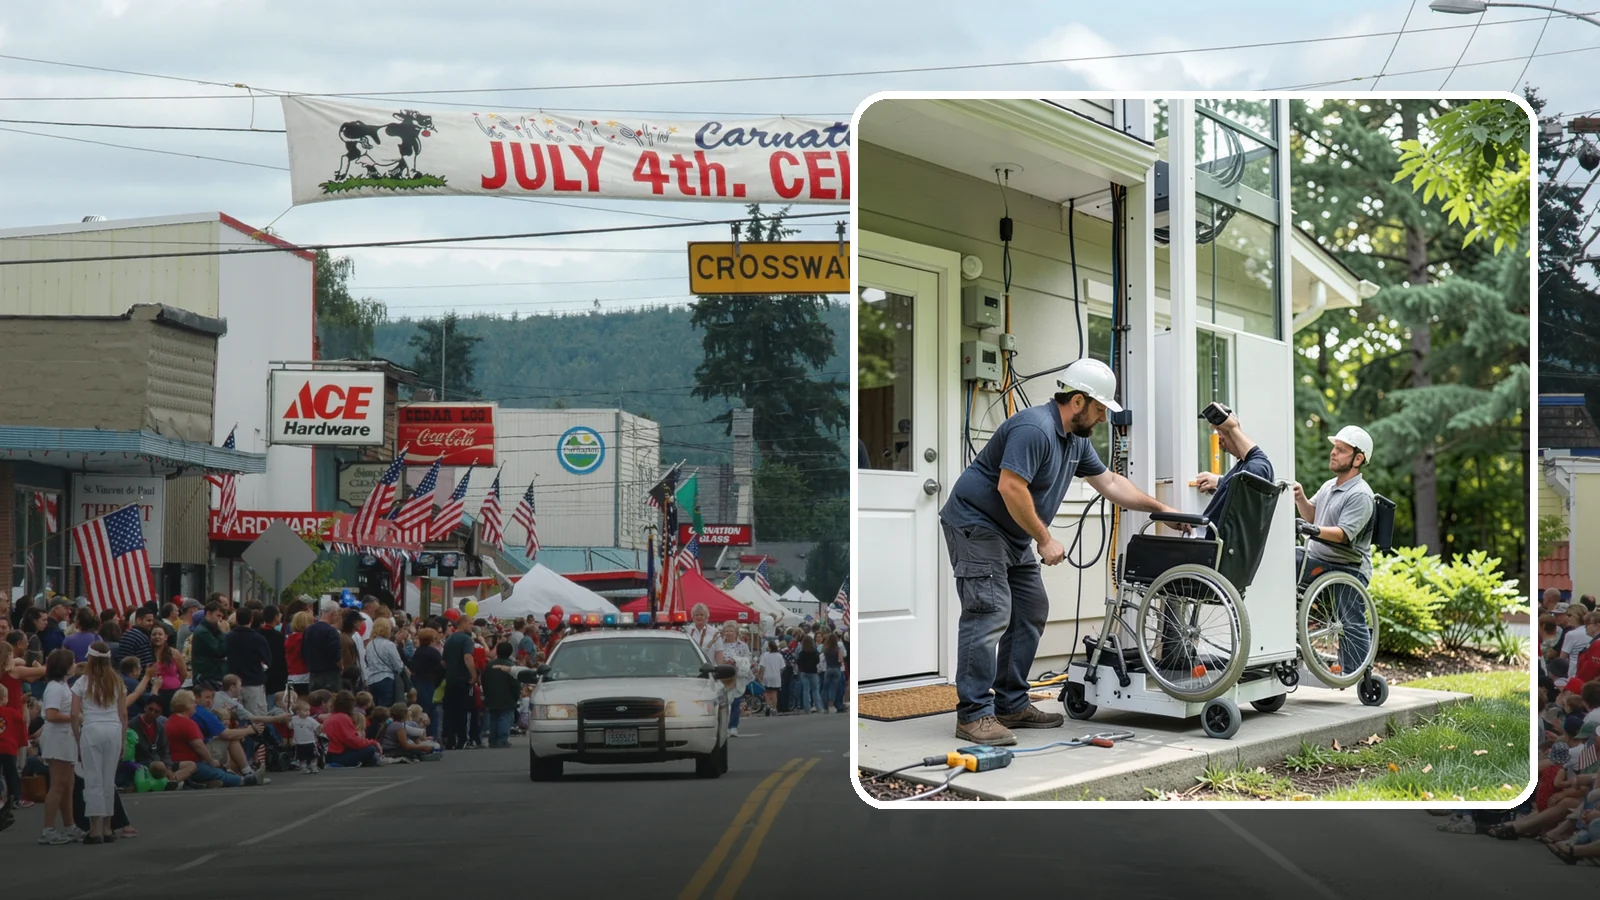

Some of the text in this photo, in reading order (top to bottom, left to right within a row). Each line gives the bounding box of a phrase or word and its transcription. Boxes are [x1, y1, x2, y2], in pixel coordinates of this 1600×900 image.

[695, 121, 850, 150] Carnat
[481, 141, 605, 193] JULY
[632, 150, 746, 198] 4th.
[697, 254, 850, 280] CROSSWA
[283, 380, 373, 420] ACE
[405, 409, 452, 421] CEDAR
[283, 421, 371, 436] Hardware
[96, 485, 124, 494] Vincent
[126, 486, 136, 494] de
[137, 486, 155, 495] Paul
[688, 526, 741, 534] CRNATION
[699, 535, 730, 543] GLASS
